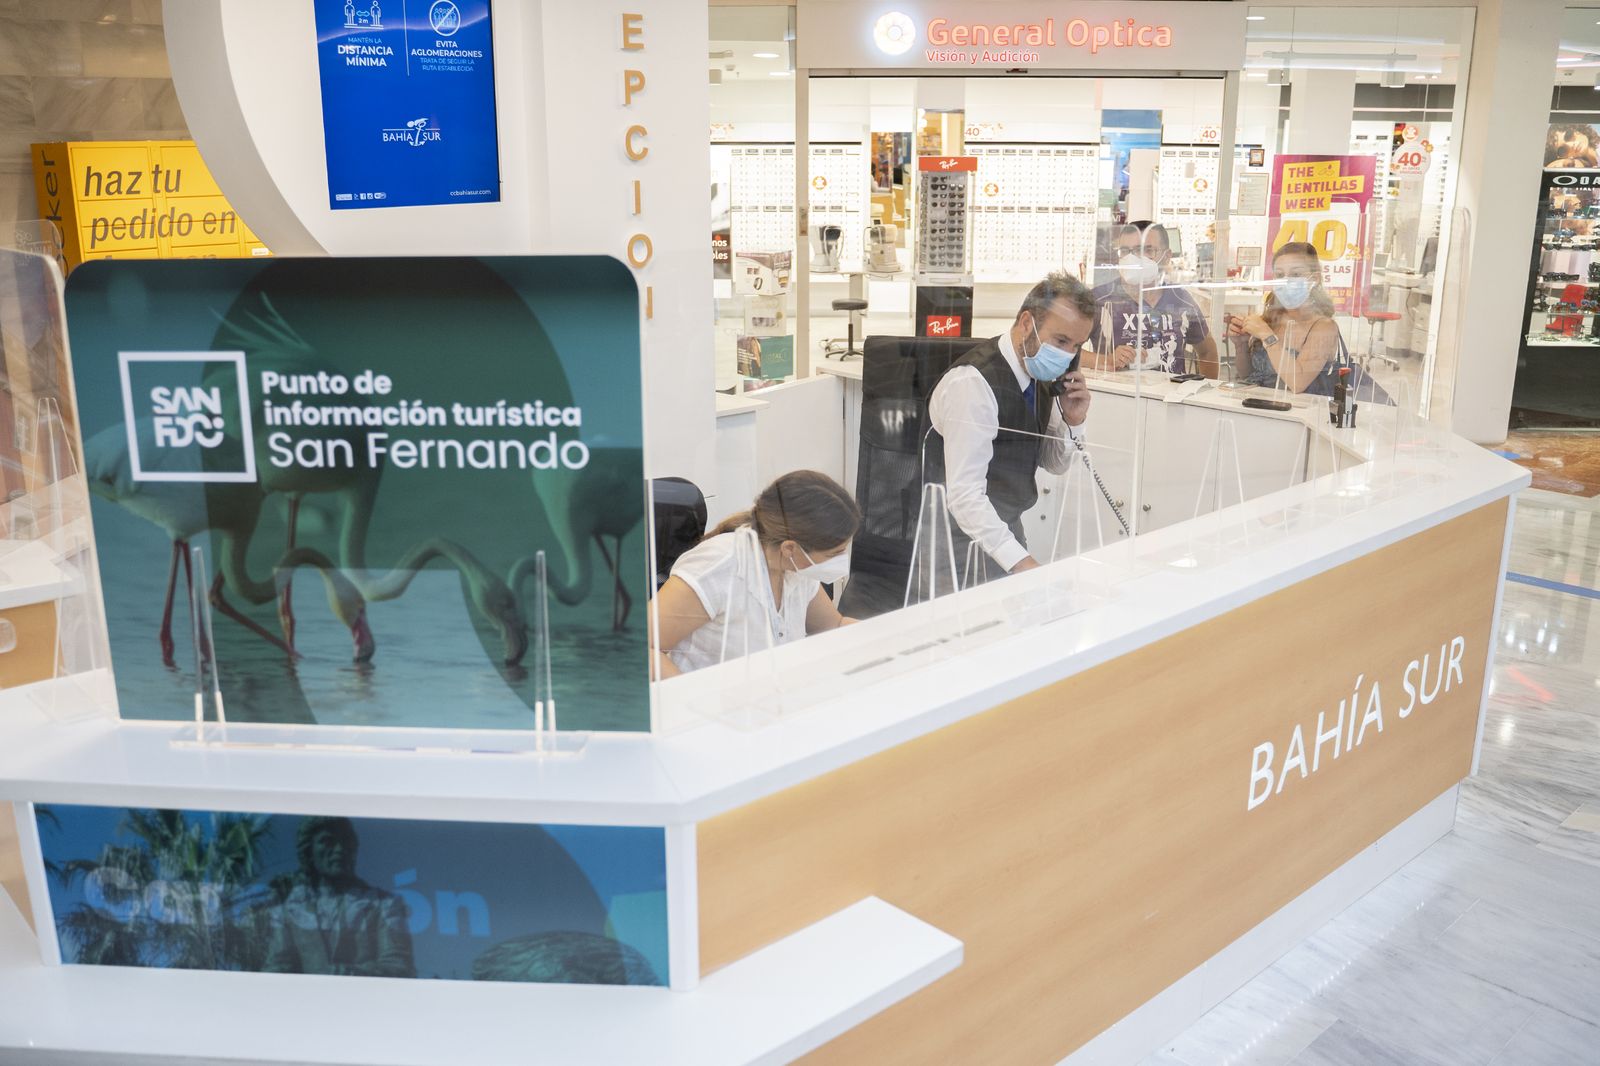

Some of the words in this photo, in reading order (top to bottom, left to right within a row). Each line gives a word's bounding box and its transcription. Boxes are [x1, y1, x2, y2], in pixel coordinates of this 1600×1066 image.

[927, 18, 1056, 47] General
[1066, 17, 1173, 54] Optica
[337, 44, 394, 56] DISTANCIA
[435, 40, 458, 48] EVITA
[411, 48, 483, 58] AGLOMERACIONES
[926, 50, 966, 62] Visión
[971, 52, 978, 64] y
[982, 50, 1040, 63] Audición
[345, 54, 387, 67] MÍNIMA
[382, 130, 414, 142] BAHÍA
[422, 131, 441, 141] SUR
[1202, 130, 1217, 139] 40
[1397, 152, 1422, 167] 40
[1288, 167, 1315, 178] THE
[84, 165, 143, 198] haz
[151, 164, 182, 194] tu
[1287, 180, 1358, 194] LENTILLAS
[1285, 197, 1325, 210] WEEK
[90, 206, 193, 249] pedido
[202, 210, 236, 235] en
[1333, 265, 1351, 274] LAS
[261, 371, 348, 394] Punto
[353, 370, 392, 394] de
[150, 386, 222, 414] SAN
[264, 400, 446, 426] información
[453, 400, 582, 426] turística
[268, 433, 354, 468] San
[367, 432, 590, 469] Fernando
[1247, 673, 1384, 811] BAHÍA
[1398, 635, 1465, 719] SUR
